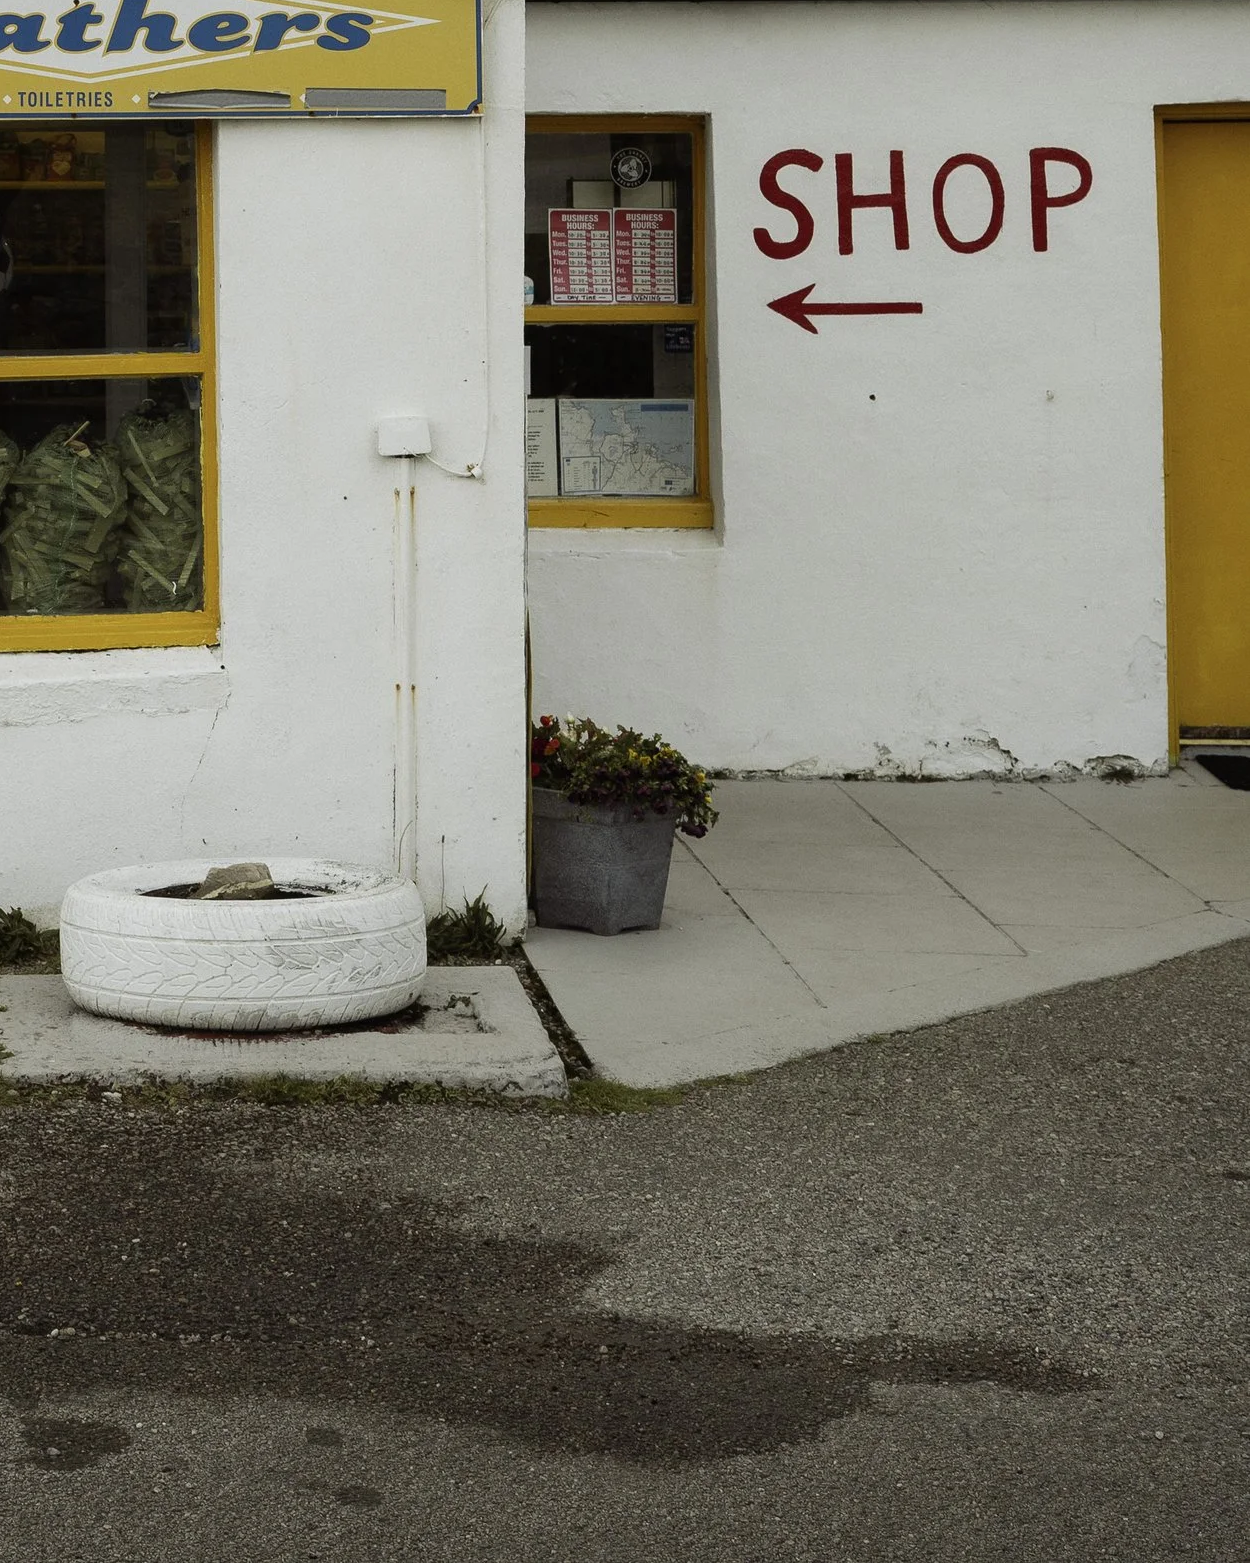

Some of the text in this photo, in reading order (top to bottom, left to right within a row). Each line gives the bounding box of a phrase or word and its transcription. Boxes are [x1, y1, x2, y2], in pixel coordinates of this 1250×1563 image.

[17, 90, 113, 108] TOILETRIES
[752, 147, 1094, 260] SHOP
[561, 214, 599, 222] BUSINESS
[626, 213, 664, 222] BUSINESS
[566, 222, 595, 230] HOURS:
[631, 221, 660, 230] HOURS:
